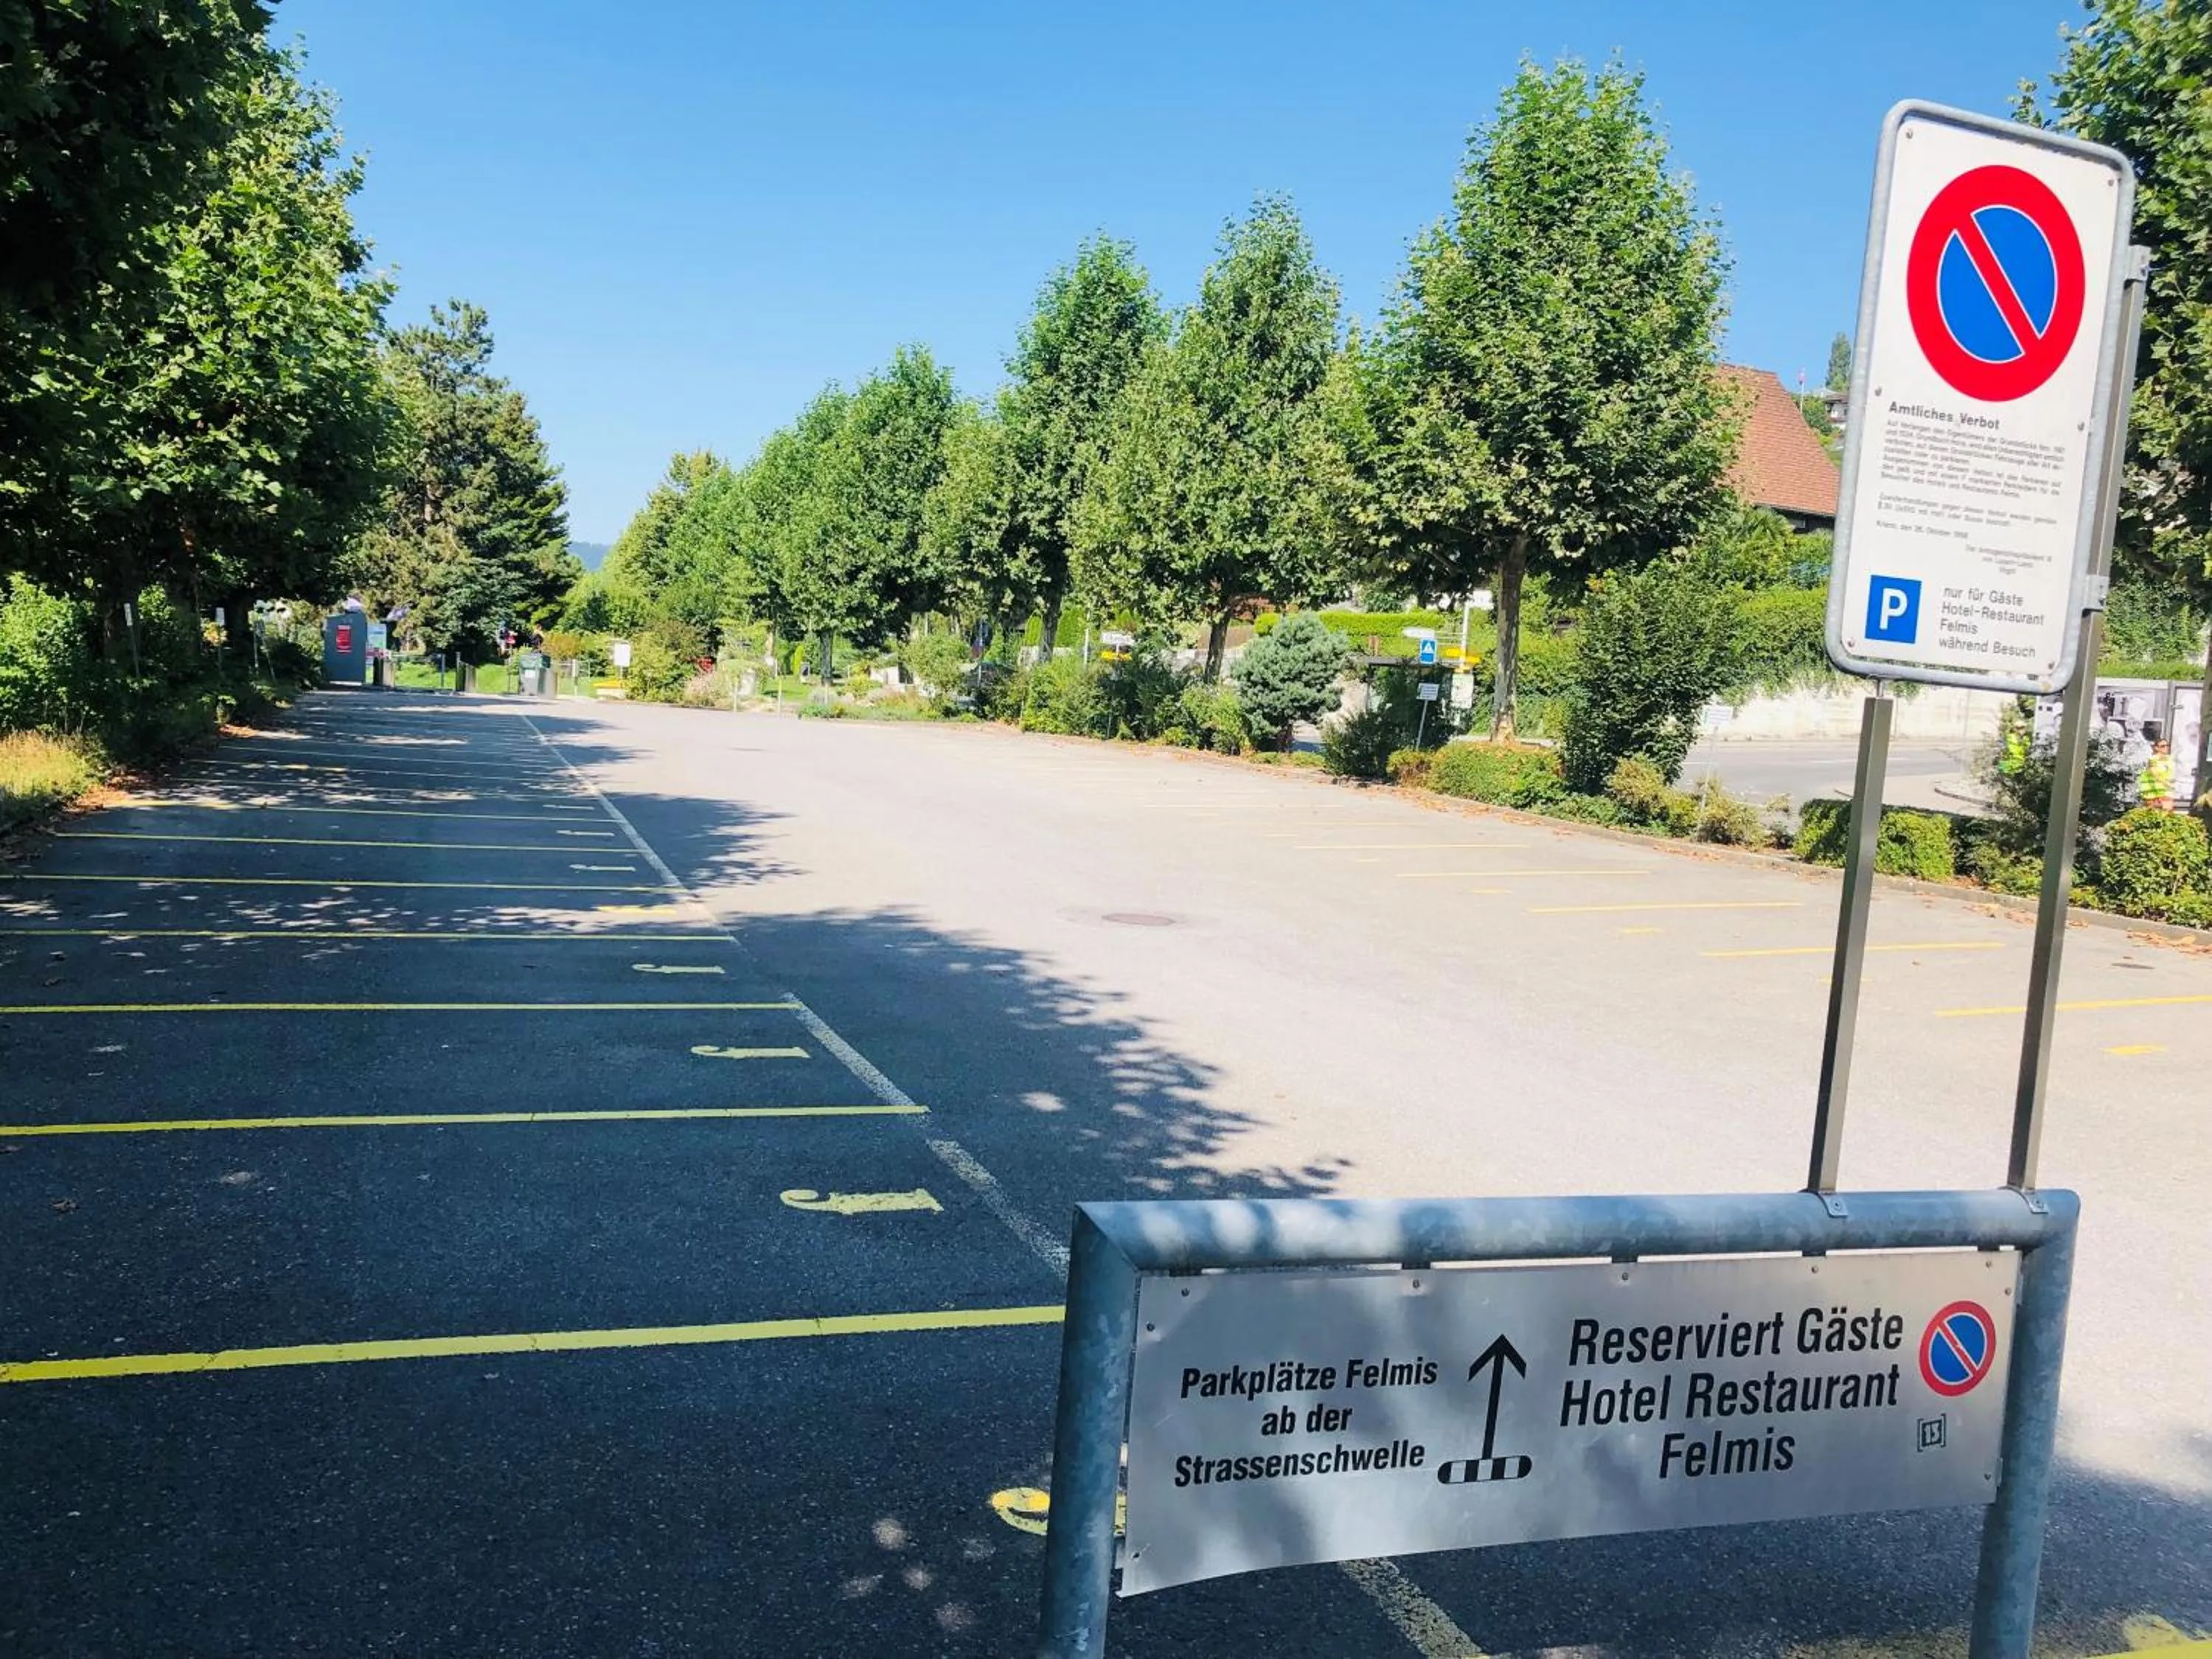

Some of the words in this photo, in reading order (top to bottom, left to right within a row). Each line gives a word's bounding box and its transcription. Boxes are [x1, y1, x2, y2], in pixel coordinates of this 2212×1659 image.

[1888, 400, 1954, 422] Amtliches
[1959, 412, 2000, 430] Verbot
[1879, 587, 1908, 630] P
[1941, 601, 2045, 626] Hotel-Restaurant
[1943, 587, 1964, 599] nur
[1967, 588, 1985, 602] für
[1989, 589, 2025, 607] Gäste
[1939, 617, 1979, 635] Felmis
[1938, 636, 1989, 653] während
[1992, 641, 2037, 658] Besuch
[1568, 1312, 1785, 1366] Reserviert
[1797, 1307, 1905, 1354] Gäste
[1180, 1360, 1338, 1402] Parkplätze
[1345, 1357, 1439, 1388] Felmis
[1559, 1374, 1672, 1427] Hotel
[1685, 1364, 1901, 1419] Restaurant
[1261, 1405, 1296, 1436] ab
[1306, 1403, 1354, 1433] der
[1175, 1439, 1425, 1487] Strassenschwelle
[1659, 1427, 1796, 1479] Felmis
